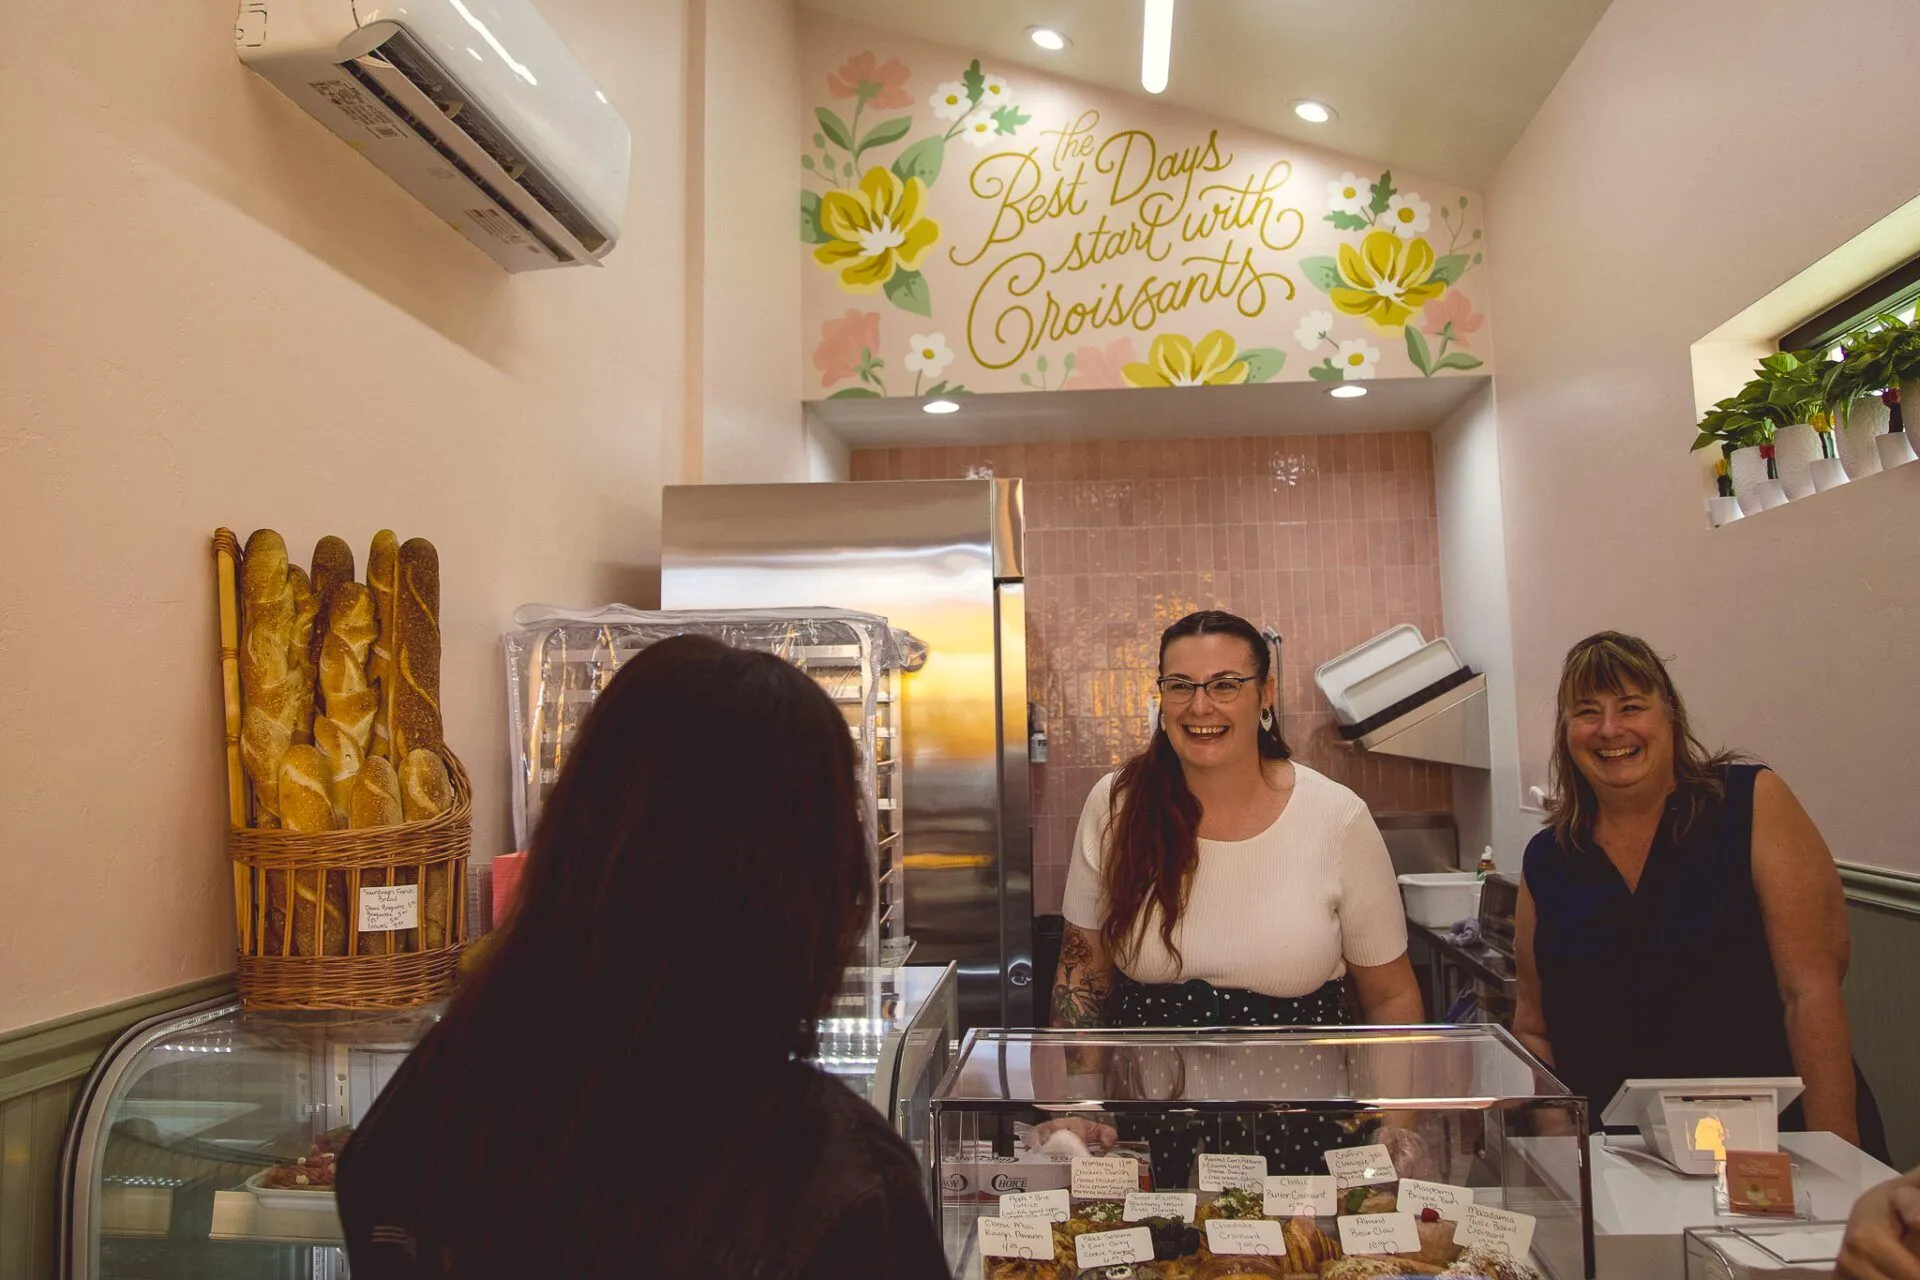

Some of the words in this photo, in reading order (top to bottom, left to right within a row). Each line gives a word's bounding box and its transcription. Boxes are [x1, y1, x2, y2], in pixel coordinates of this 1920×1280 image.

[1040, 110, 1099, 171] the
[949, 147, 1088, 266] Best
[1095, 130, 1232, 222] Days
[1051, 195, 1172, 272] start
[1182, 160, 1303, 250] with
[967, 240, 1295, 370] Croissants
[1349, 1227, 1372, 1237] Bear
[1373, 1227, 1395, 1235] Claw
[1356, 1217, 1386, 1225] Almond
